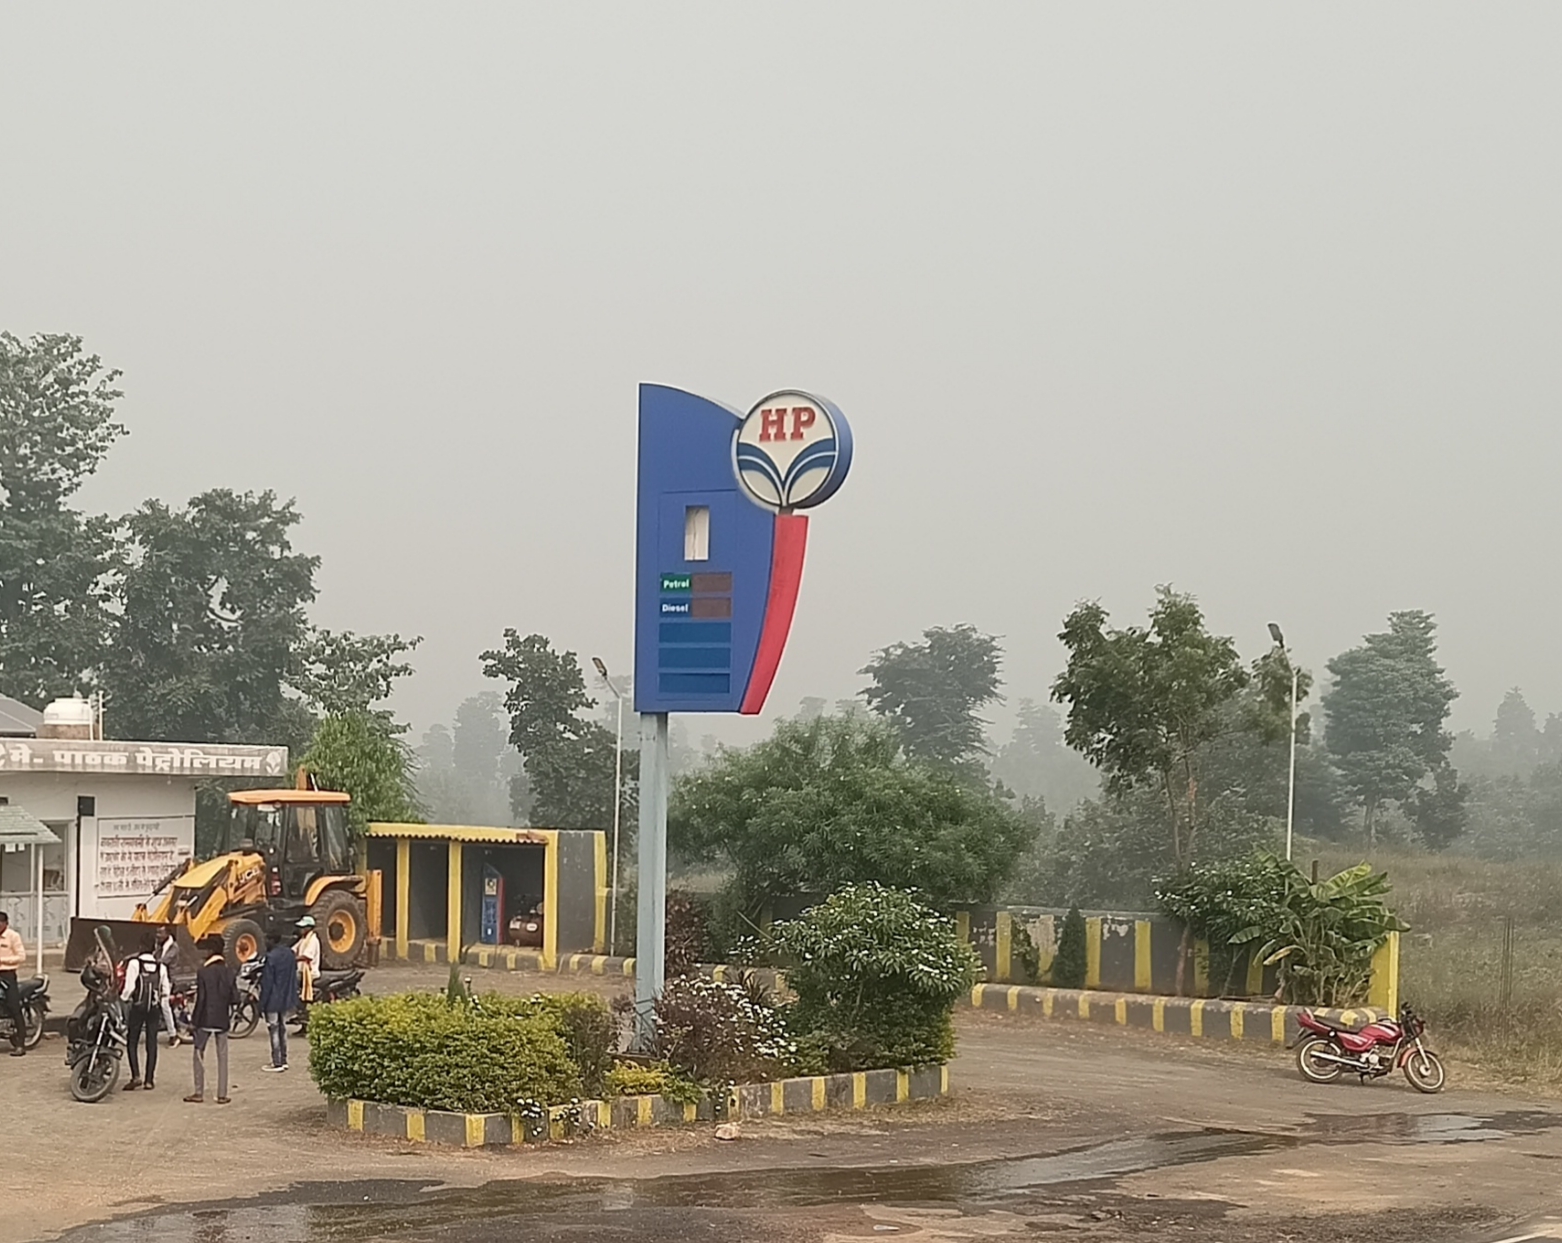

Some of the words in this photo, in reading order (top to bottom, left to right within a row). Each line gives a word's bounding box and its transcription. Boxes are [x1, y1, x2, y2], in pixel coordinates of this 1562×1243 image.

[759, 406, 817, 443] HP
[662, 578, 690, 590] Petrol
[661, 603, 689, 614] Diesel
[52, 749, 129, 766] पाठक
